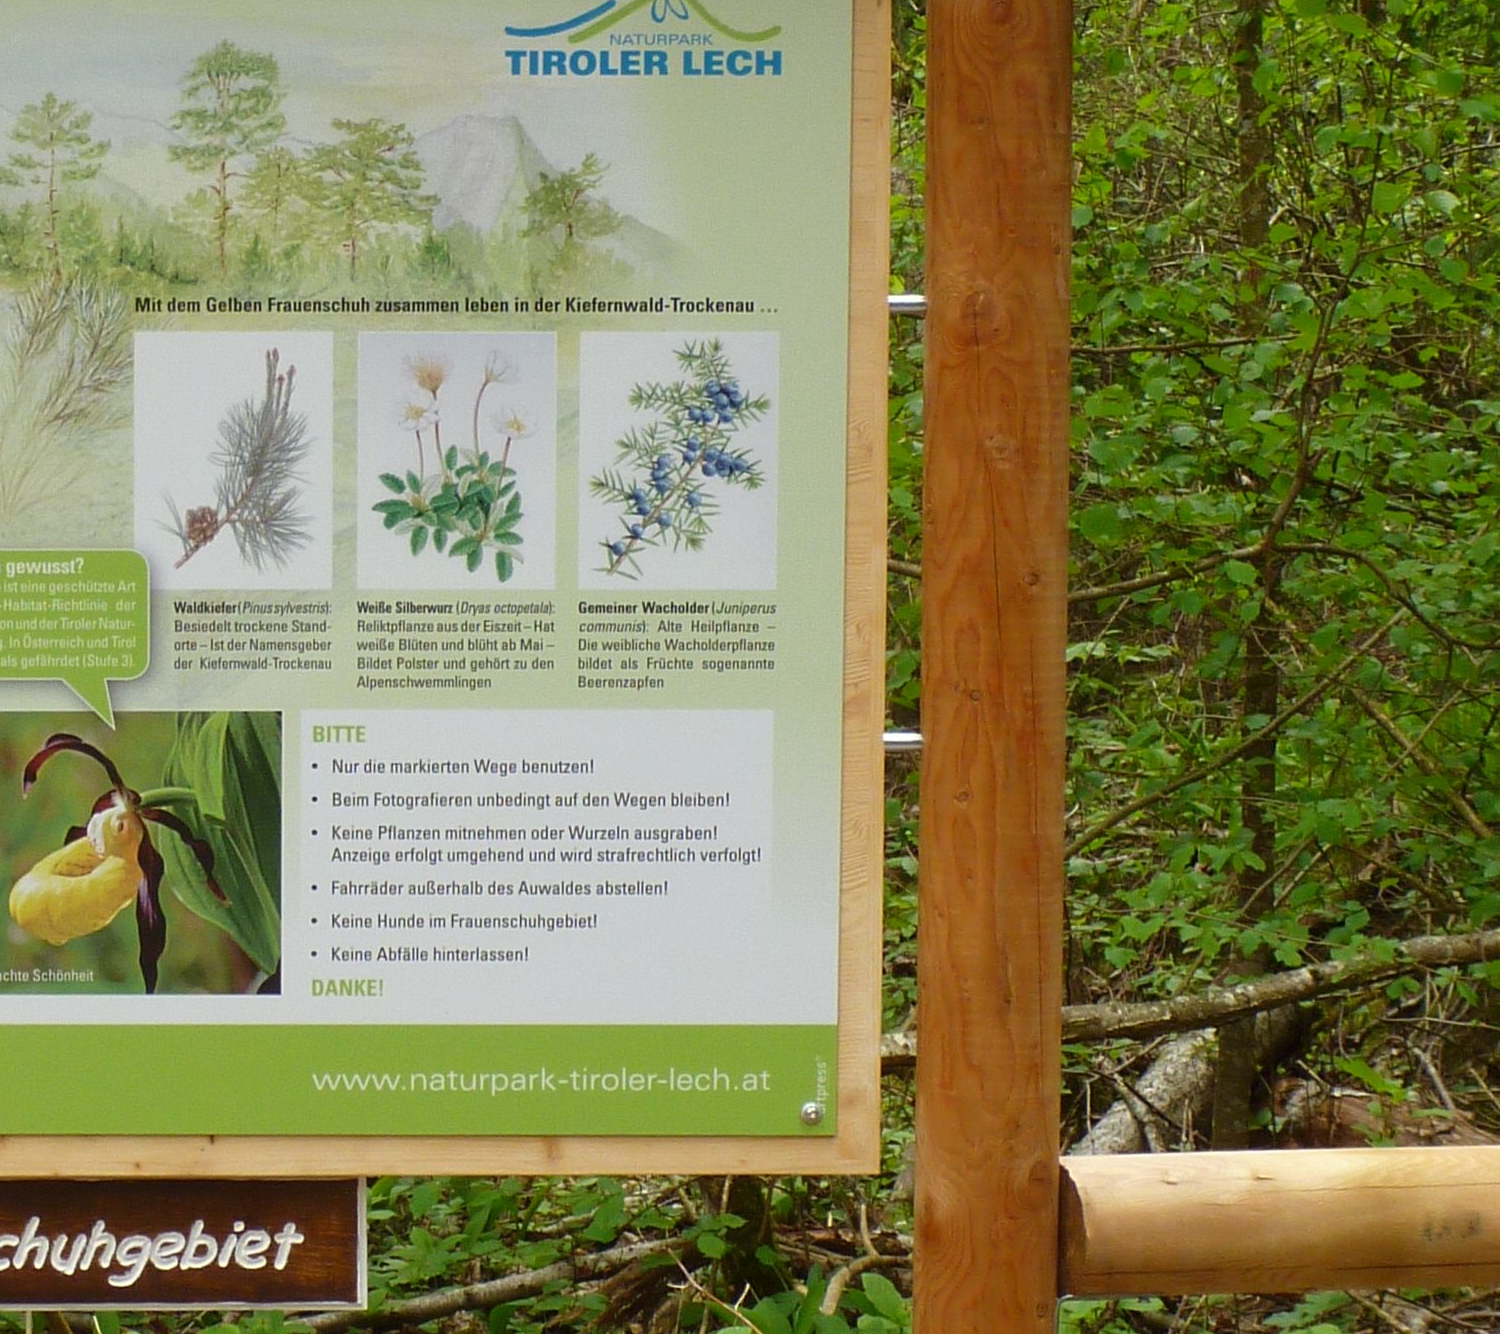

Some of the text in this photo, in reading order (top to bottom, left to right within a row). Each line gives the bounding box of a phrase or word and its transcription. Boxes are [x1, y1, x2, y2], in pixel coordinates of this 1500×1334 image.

[609, 33, 713, 45] NATURPARK
[505, 50, 782, 76] TIROLER LECH
[135, 296, 754, 314] Mit dem Gelben Frauenschuh zusammen leben in der Kiefernwald-Trockenau
[5, 557, 84, 577] gewusst?
[356, 601, 392, 614] Weiße
[395, 601, 453, 614] Silberwurz
[455, 601, 491, 617] (Dryas
[578, 601, 776, 617] Gemeiner Wacholder (Juniperus
[174, 619, 332, 633] Besiedelt trockene Stand-
[357, 619, 555, 636] Reliktpflanze aus der Eiszeit Hat
[657, 620, 682, 633] Alte
[691, 619, 760, 635] Heilpflanze
[173, 638, 332, 654] orte Ist der Namensgeber
[356, 637, 544, 652] weiße Blüten und blüht ab Mai
[578, 638, 775, 654] Die weibliche Wacholderpflanze
[173, 656, 332, 669] der Kiefernwald-Trockenau
[357, 657, 555, 672] Bildet Polster und gehört zu den
[577, 656, 775, 672] bildet als Früchte sogenannte
[356, 675, 492, 691] Alpenschwemmlingen
[577, 675, 664, 691] Beerenzapfen
[312, 725, 366, 743] BITTE
[332, 758, 594, 777] Nur die markierten Wege benutzen!
[332, 791, 730, 810] Beim Fotografieren unbedingt auf den Wegen bleiben!
[331, 824, 717, 843] Keine Pflanzen mitnehmen oder Wurzeln ausgraben!
[331, 847, 761, 866] Anzeige erfolgt umgehend und wird strafrechtlich verfolgt!
[331, 880, 668, 895] Fahrräder außerhalb des Auwaldes abstellen!
[331, 913, 597, 932] Keine Hunde im Frauenschuhgebiet!
[331, 946, 529, 961] Keine Abfälle hinterlassen!
[32, 969, 94, 981] Schönheit
[312, 979, 384, 997] DANKE!
[312, 1069, 771, 1097] www.naturpark-tiroler-lech.at
